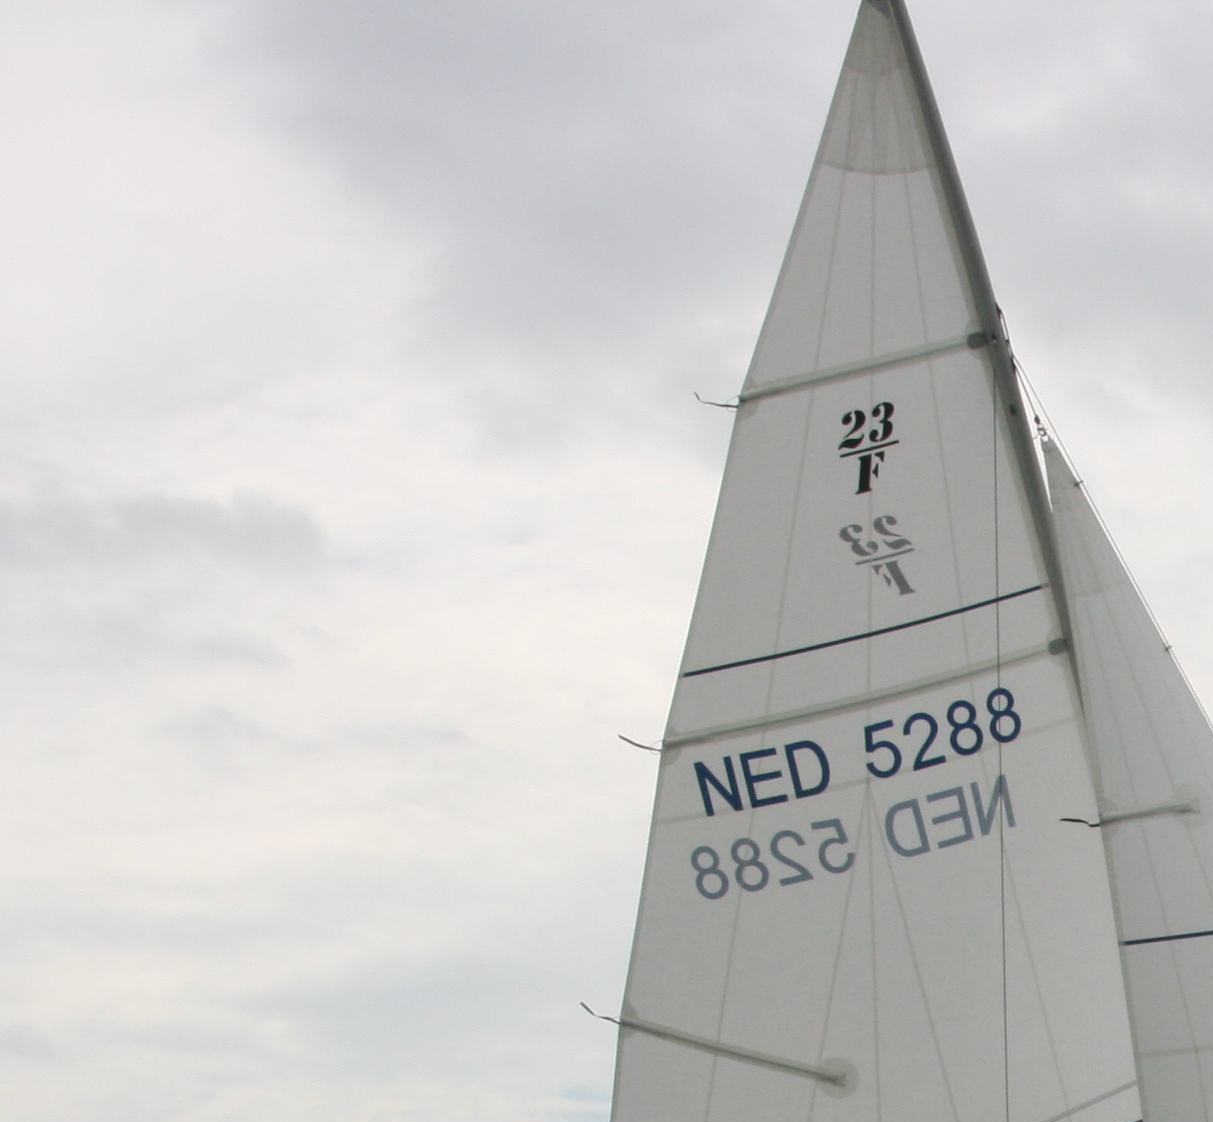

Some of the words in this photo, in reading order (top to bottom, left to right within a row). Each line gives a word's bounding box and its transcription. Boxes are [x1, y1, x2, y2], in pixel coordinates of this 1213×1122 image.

[839, 402, 896, 450] 23
[855, 451, 886, 495] F
[693, 739, 831, 817] NED
[864, 687, 1022, 779] 5288
